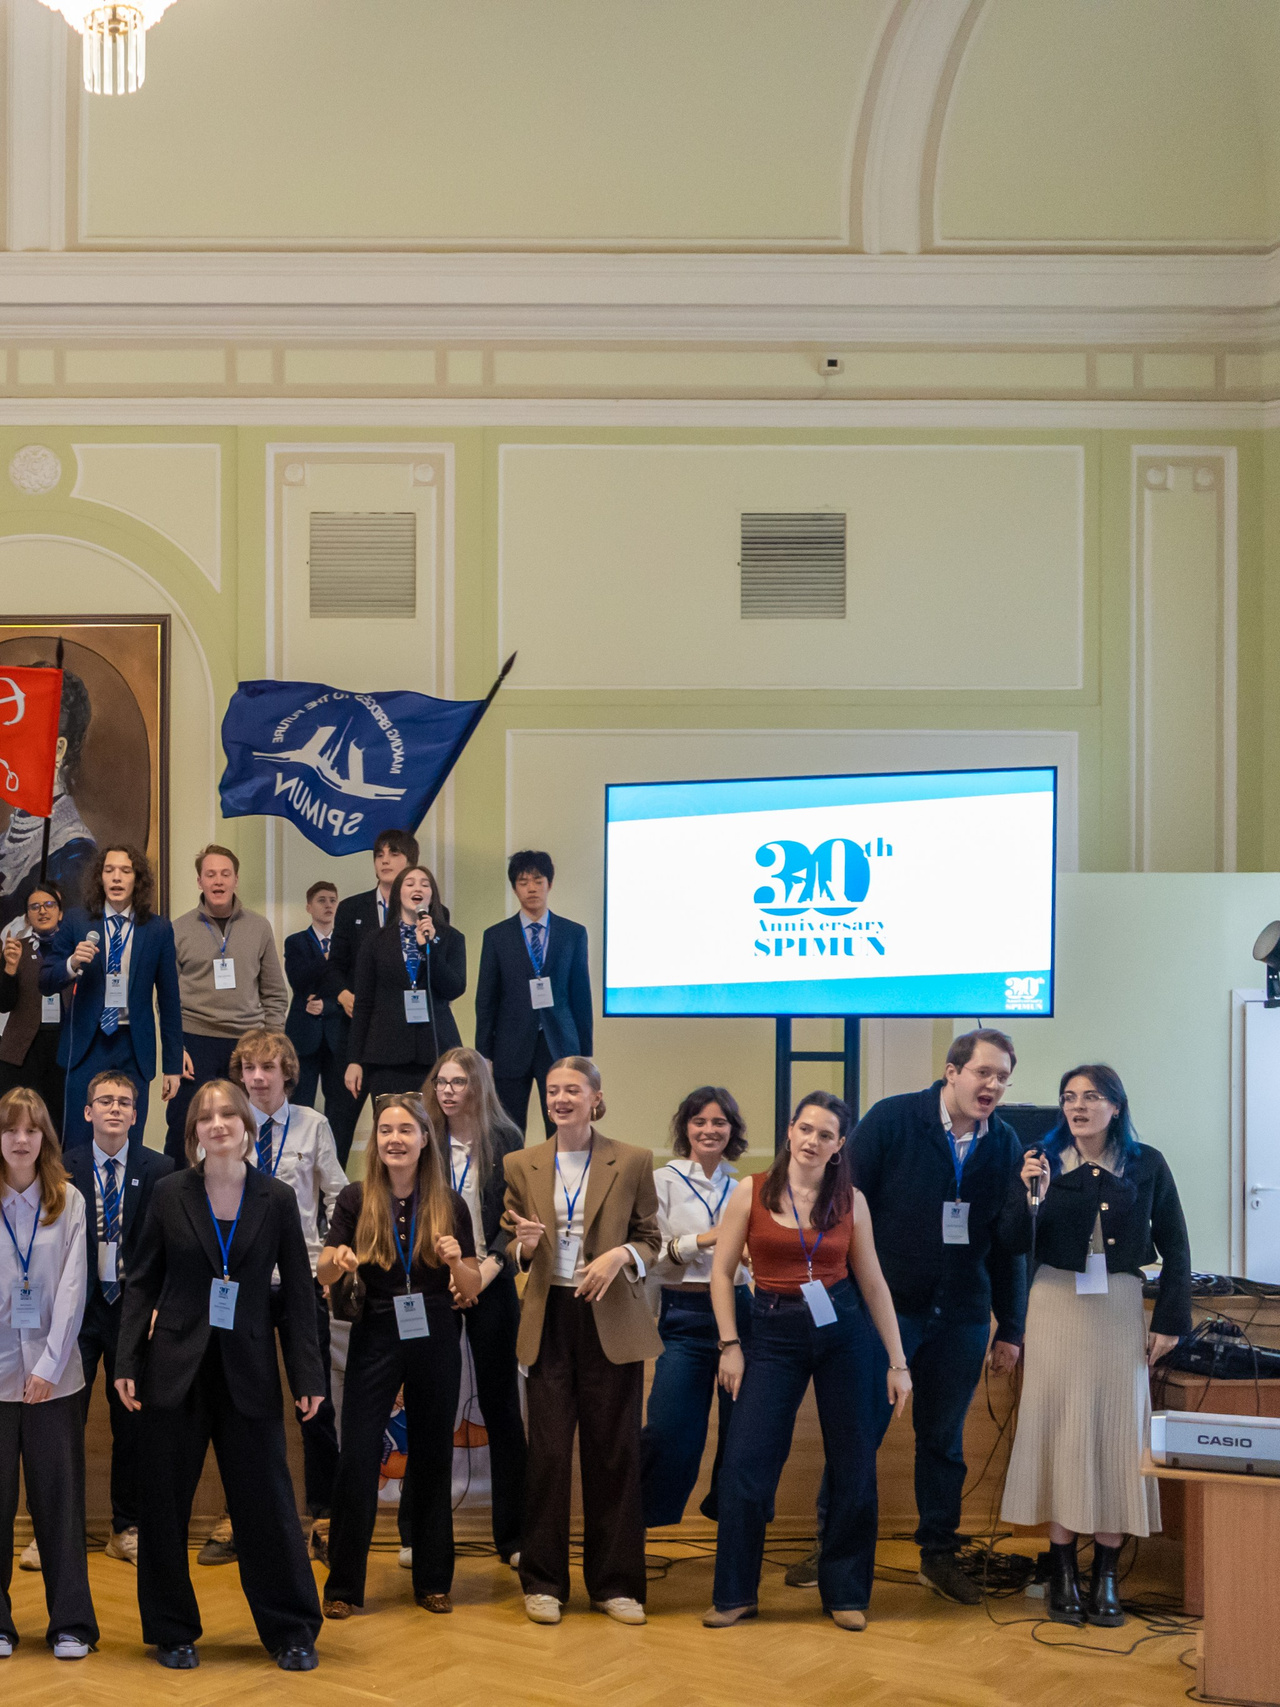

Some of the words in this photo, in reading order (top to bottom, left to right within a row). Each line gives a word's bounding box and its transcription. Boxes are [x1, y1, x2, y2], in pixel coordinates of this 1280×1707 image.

[759, 918, 885, 934] Anniversary
[754, 936, 886, 957] SPIMUN
[1197, 1434, 1253, 1448] CASIO
